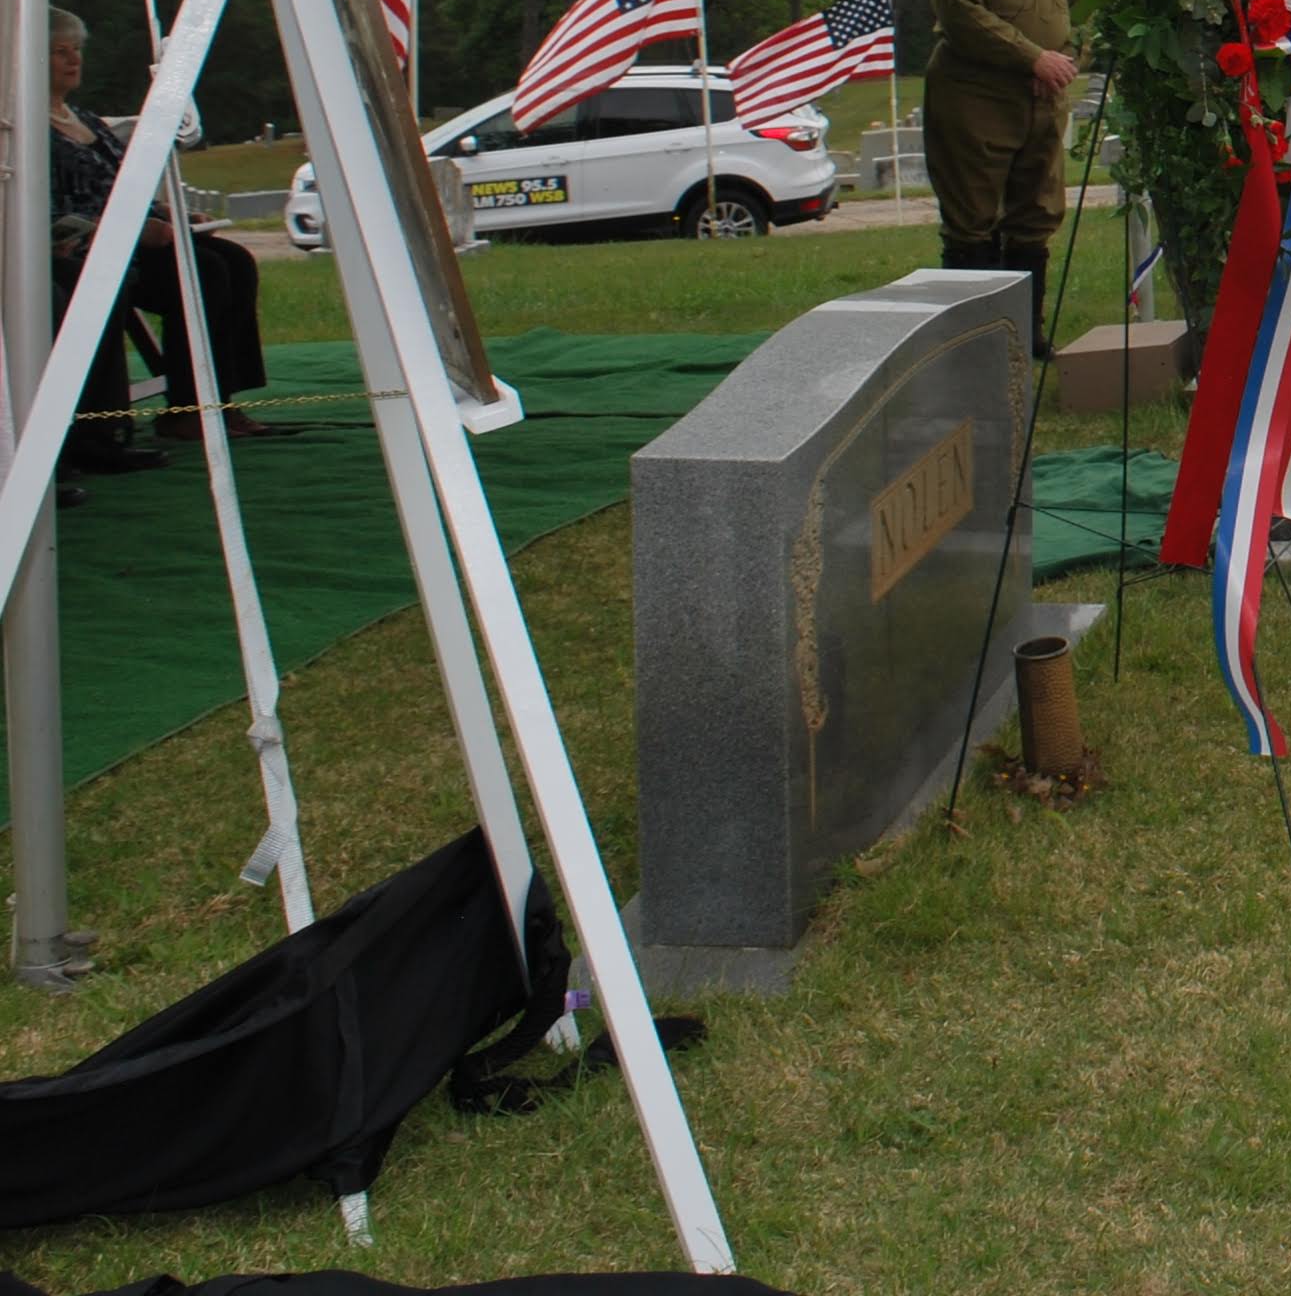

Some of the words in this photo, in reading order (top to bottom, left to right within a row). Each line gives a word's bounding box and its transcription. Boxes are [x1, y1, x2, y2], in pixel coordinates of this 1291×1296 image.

[472, 181, 518, 195] NEWS
[521, 178, 558, 192] 95.5
[496, 193, 526, 206] 750
[530, 190, 565, 203] WSB
[879, 442, 967, 576] NOLEN
